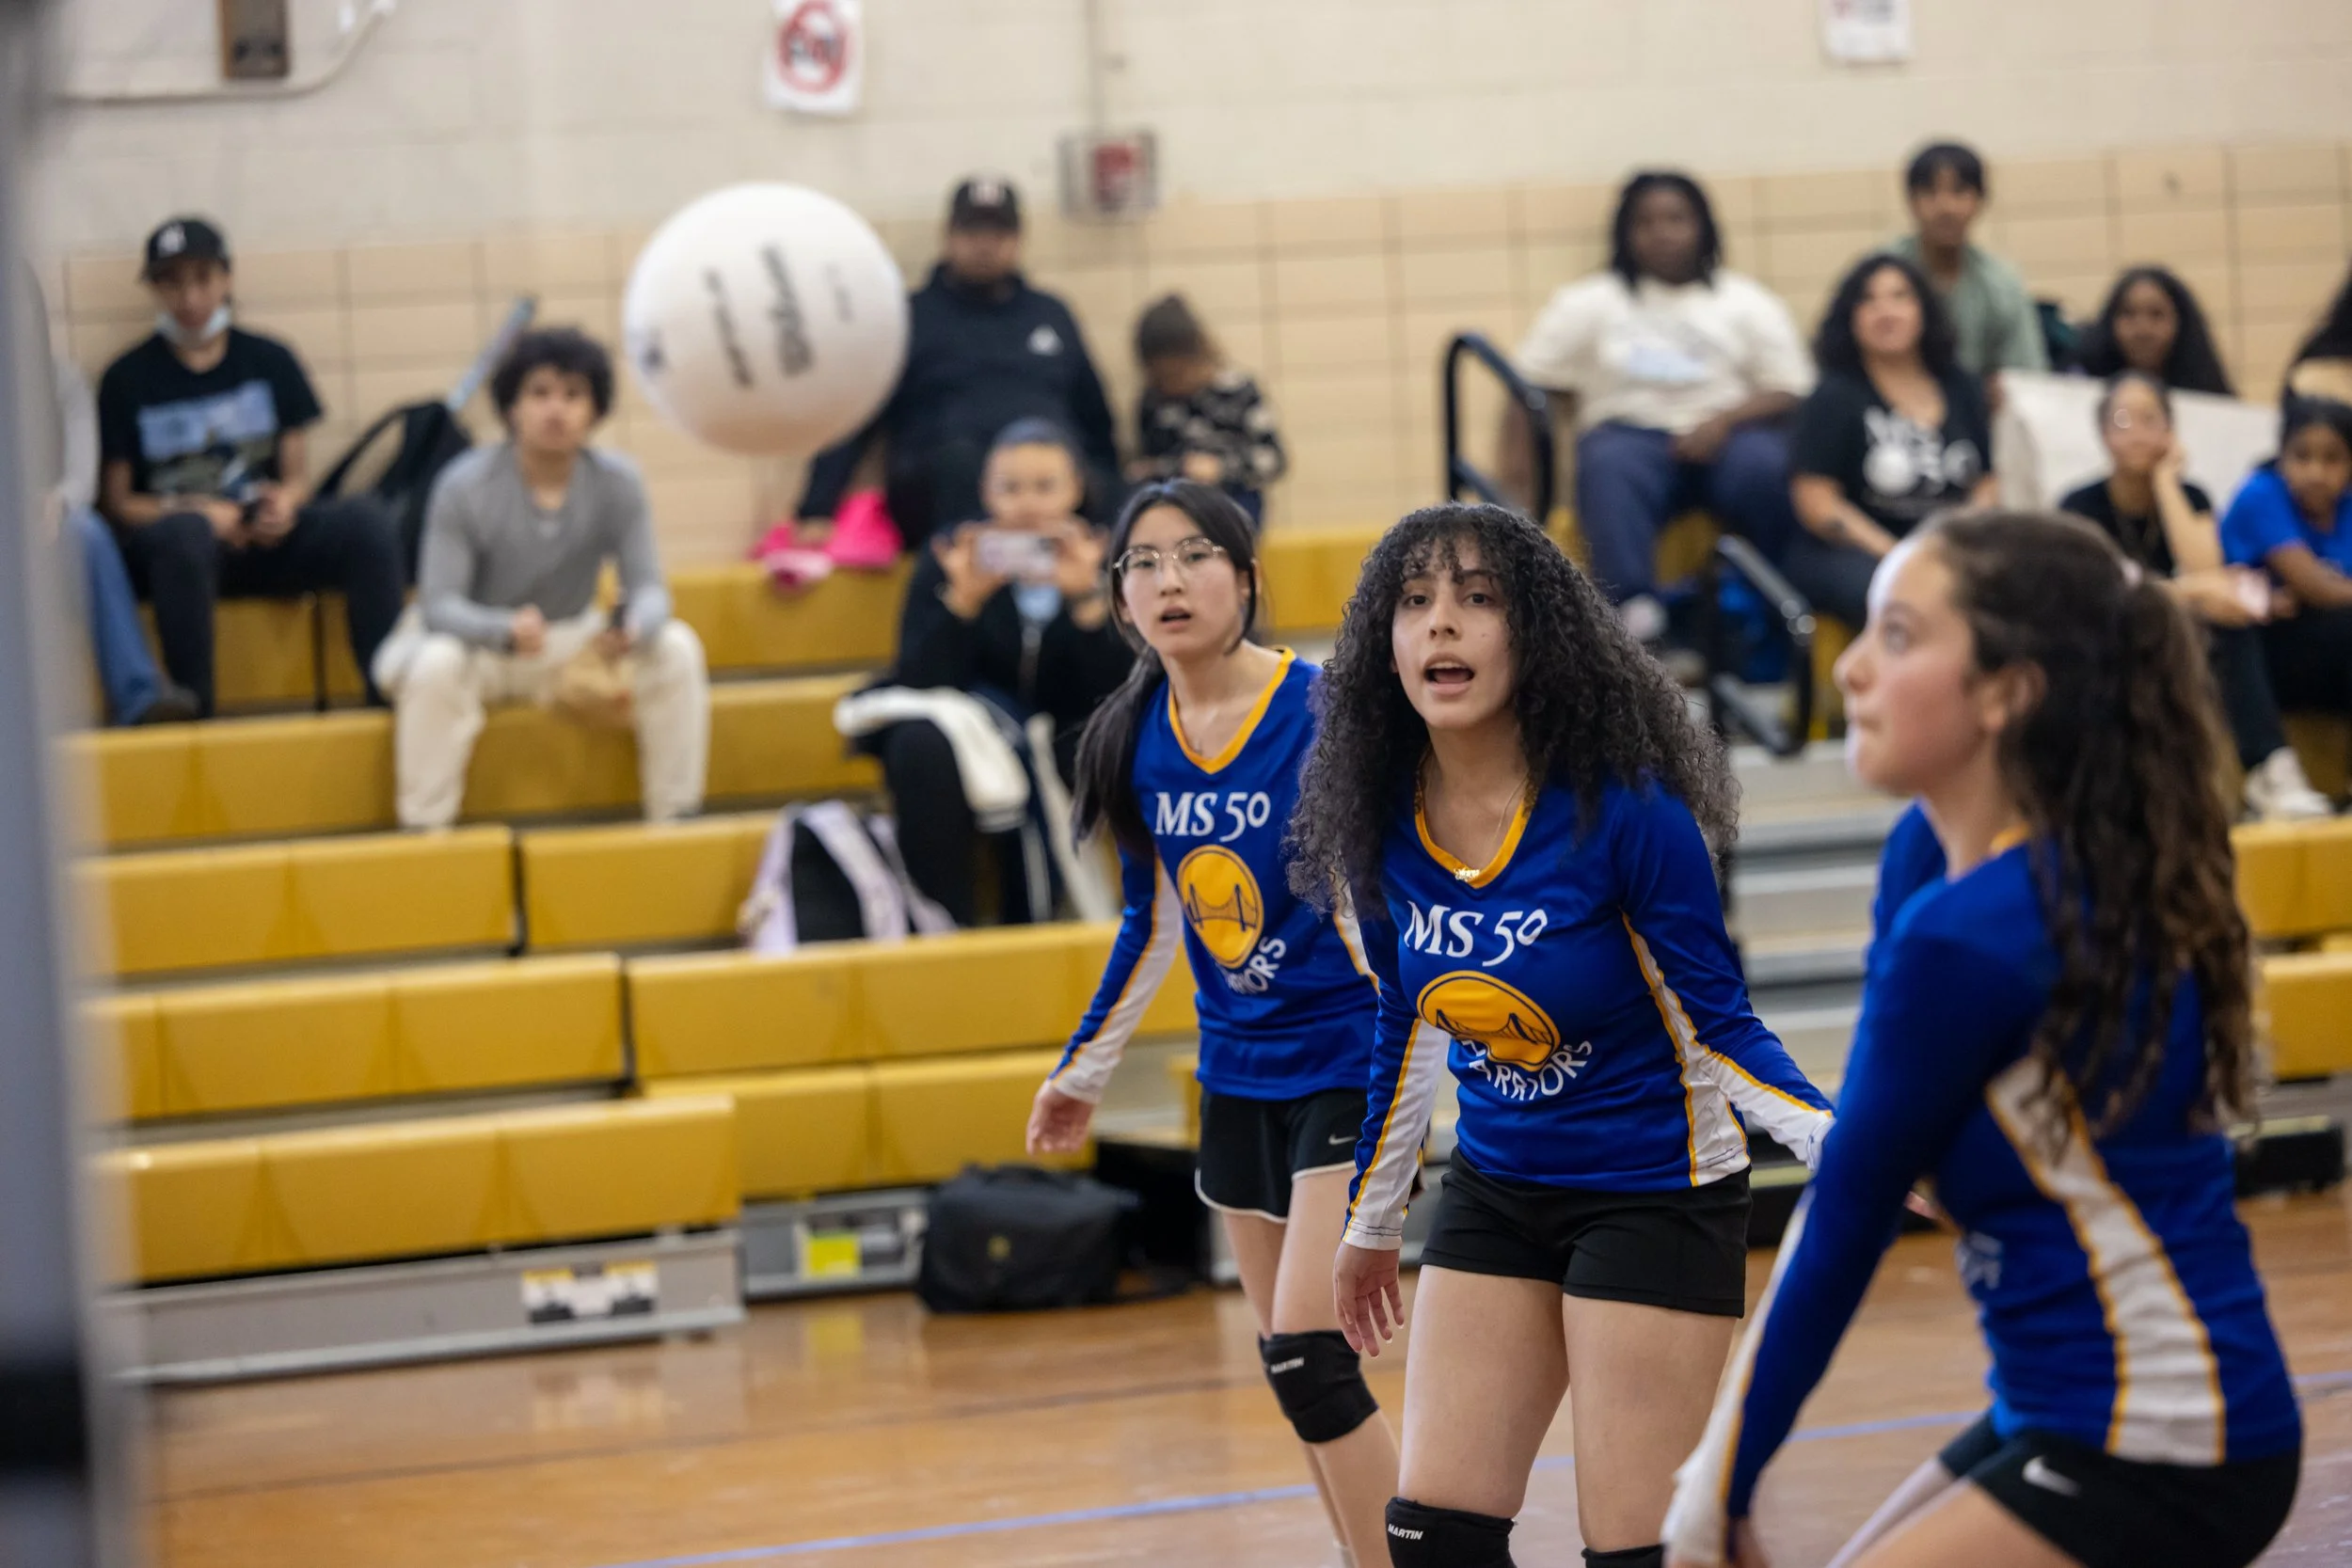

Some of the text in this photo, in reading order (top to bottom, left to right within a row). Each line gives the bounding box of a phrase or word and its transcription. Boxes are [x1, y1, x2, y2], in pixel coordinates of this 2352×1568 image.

[1154, 792, 1271, 842] MS 50
[1404, 900, 1548, 967] MS 50
[1388, 1523, 1423, 1540] MARTIN
